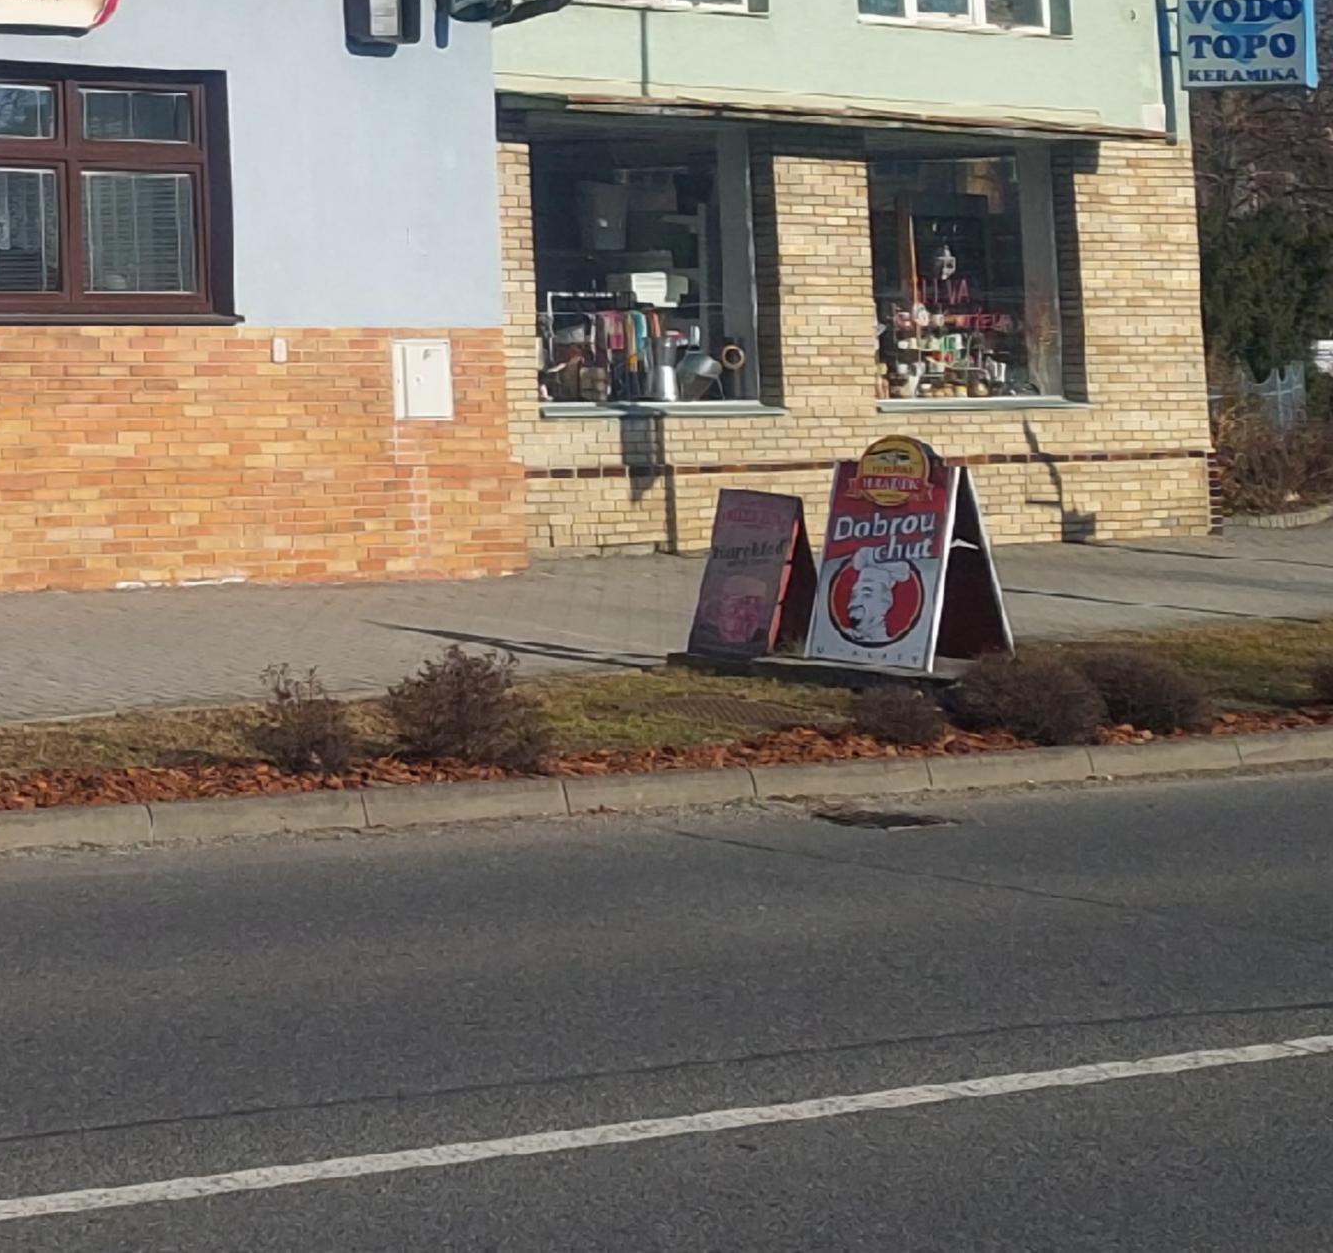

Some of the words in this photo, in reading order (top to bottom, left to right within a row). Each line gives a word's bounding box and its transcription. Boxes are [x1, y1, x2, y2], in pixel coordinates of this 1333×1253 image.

[1187, 32, 1296, 59] TOPO
[1187, 68, 1299, 83] KERAMIKA
[833, 512, 936, 541] Dobrou
